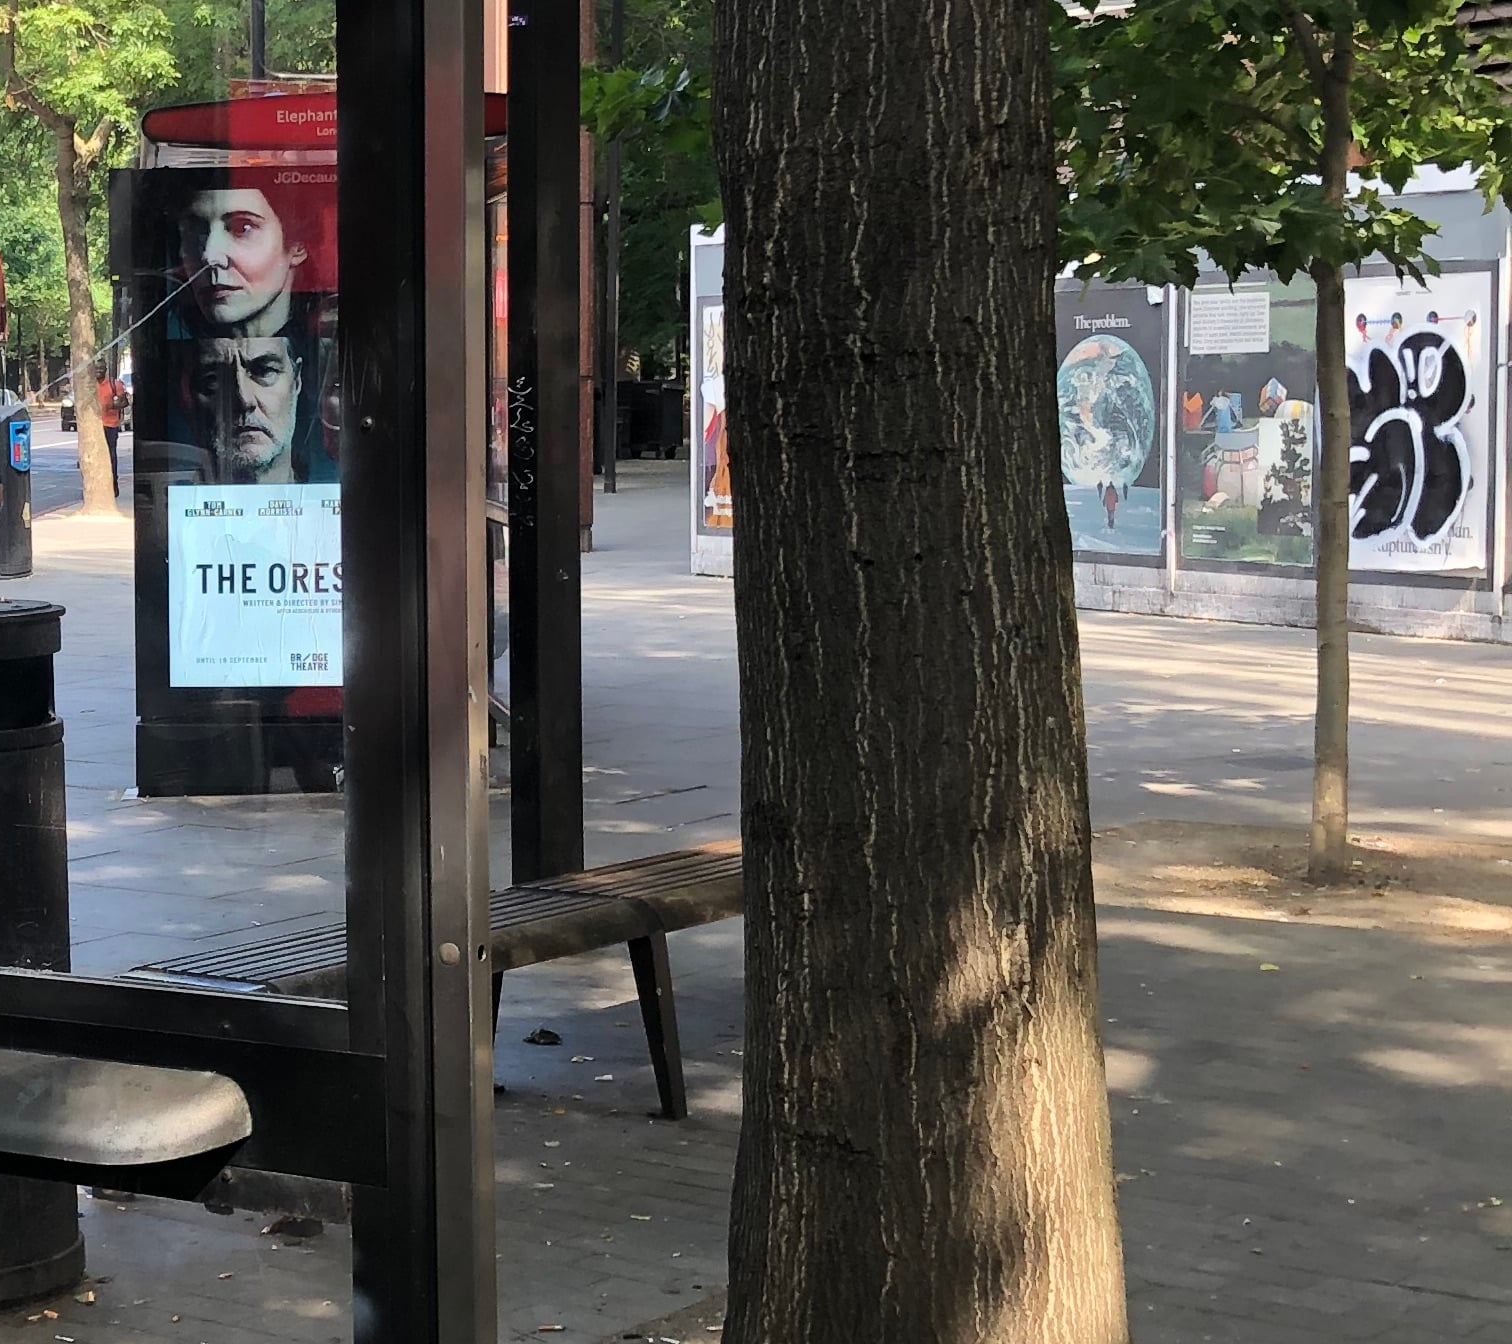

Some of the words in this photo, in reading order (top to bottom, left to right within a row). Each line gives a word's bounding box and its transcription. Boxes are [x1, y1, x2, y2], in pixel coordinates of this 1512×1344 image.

[1073, 314, 1092, 329] The
[1092, 313, 1132, 333] problem.
[196, 563, 256, 594] THE
[268, 562, 342, 594] ORES
[290, 662, 329, 671] THEATRE
